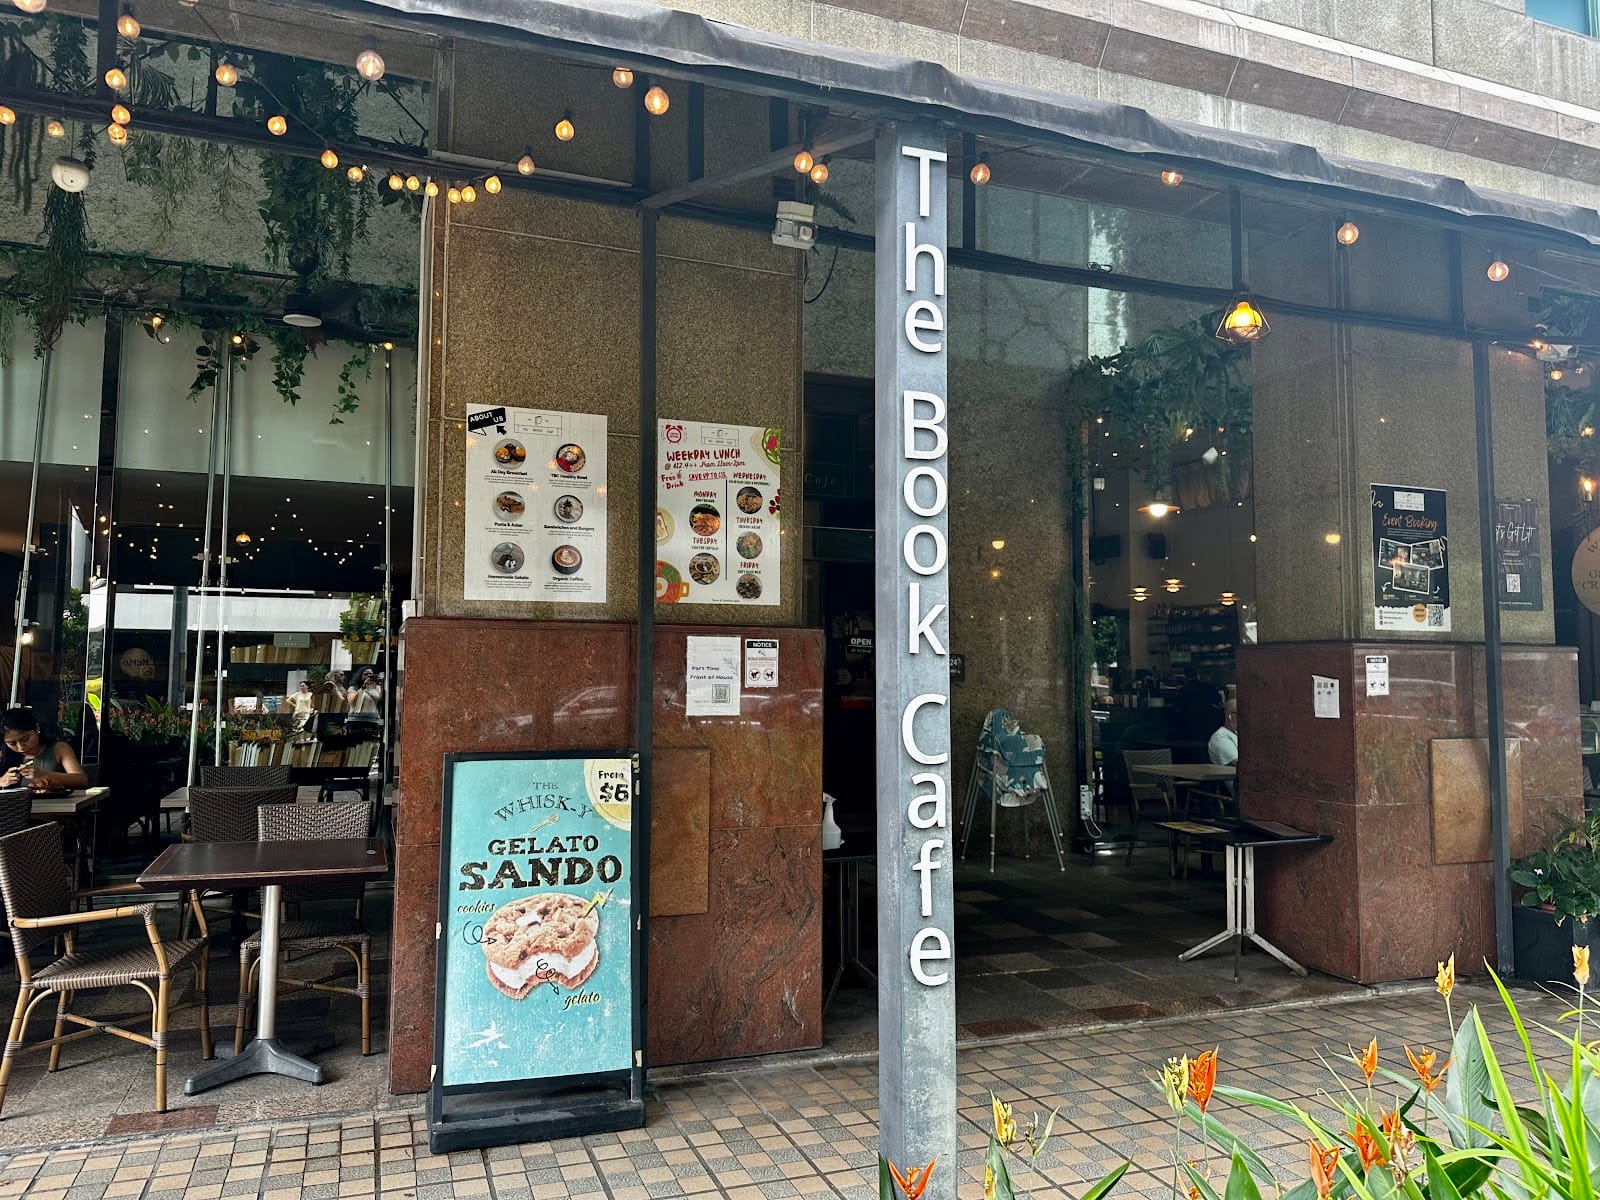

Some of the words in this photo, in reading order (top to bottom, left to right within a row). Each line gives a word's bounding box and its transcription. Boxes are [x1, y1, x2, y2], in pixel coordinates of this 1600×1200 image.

[901, 145, 949, 354] The
[469, 411, 493, 423] ABOUT
[493, 415, 504, 423] US
[666, 449, 710, 462] WEEKDAY
[713, 447, 741, 460] LUNCH
[661, 474, 676, 482] Free
[732, 472, 767, 480] WEDNESDAY
[665, 480, 684, 490] Drink
[693, 490, 717, 499] MONDAY
[735, 516, 763, 524] THURSDAY
[903, 390, 949, 656] Book
[1382, 513, 1403, 528] Event
[1405, 514, 1438, 533] Booking
[692, 536, 718, 545] TUESDAY
[739, 561, 759, 569] FRIDAY
[850, 637, 872, 646] OPEN
[598, 770, 624, 779] From
[532, 782, 559, 790] THE
[599, 782, 629, 803] $6
[488, 835, 599, 856] GELATO
[902, 693, 951, 987] Cafe
[458, 855, 622, 891] SANDO
[457, 900, 496, 914] cookies
[562, 988, 601, 1011] gelato
